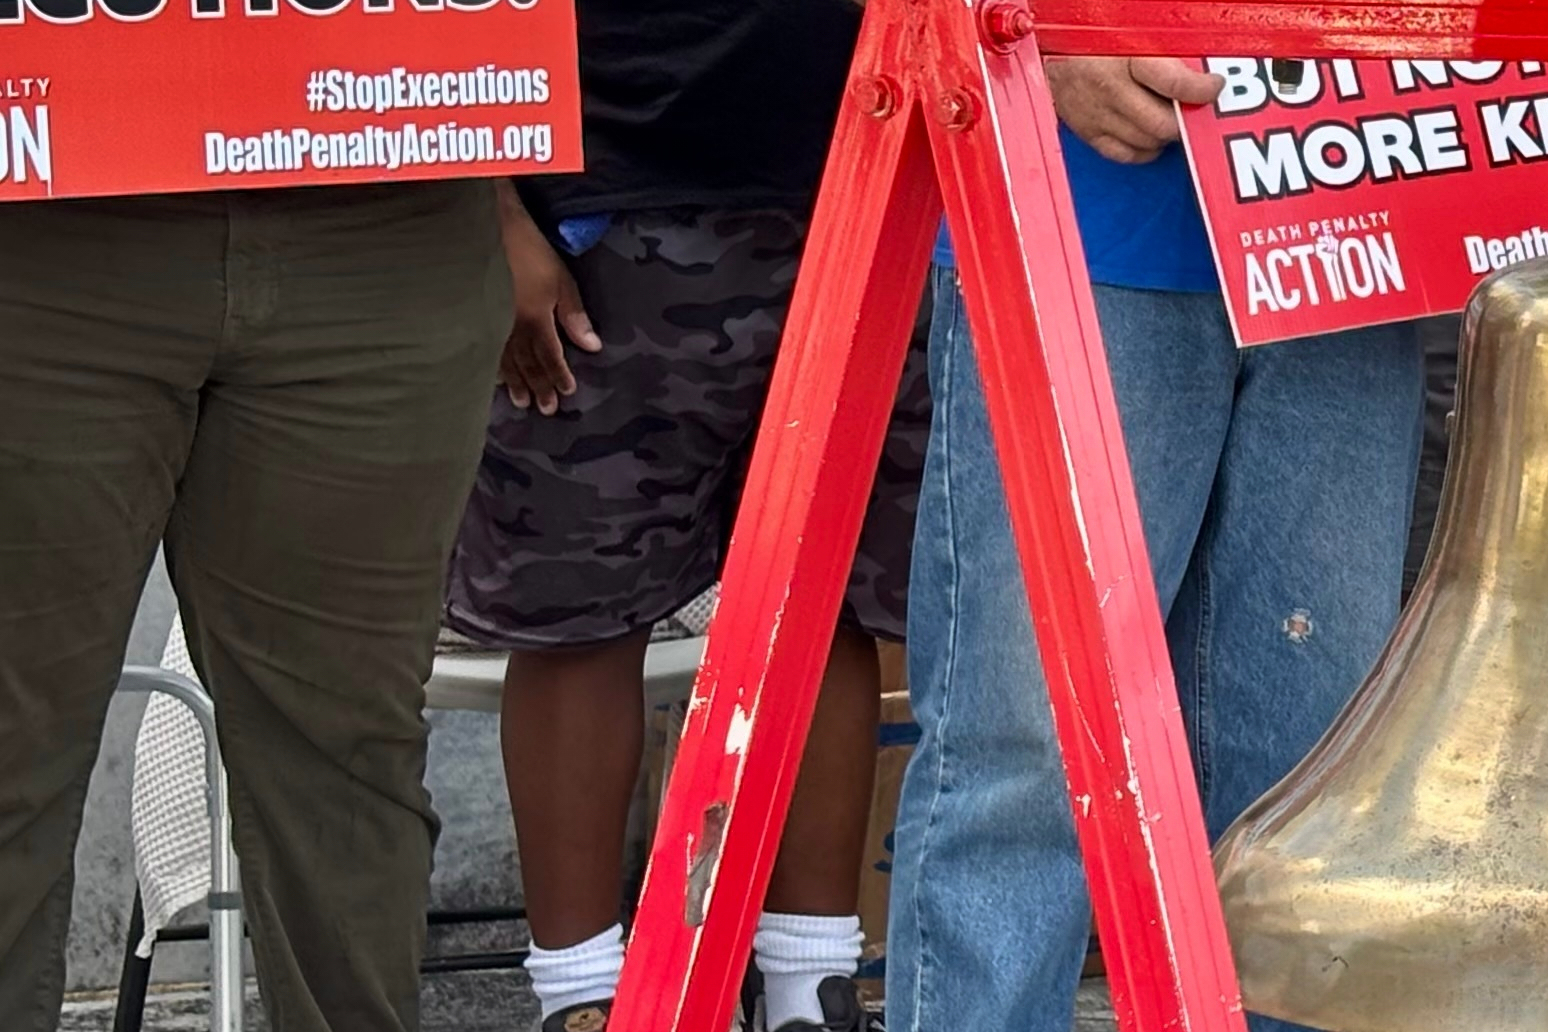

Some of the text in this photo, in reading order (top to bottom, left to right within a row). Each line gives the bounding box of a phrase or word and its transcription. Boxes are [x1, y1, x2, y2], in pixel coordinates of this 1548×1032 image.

[307, 64, 549, 114] #StopExecutions
[205, 122, 552, 174] DeathPenaltyAction.org
[1229, 113, 1467, 197] MORE
[1240, 210, 1390, 248] DEATH PENALTY
[1246, 232, 1406, 316] ACTION
